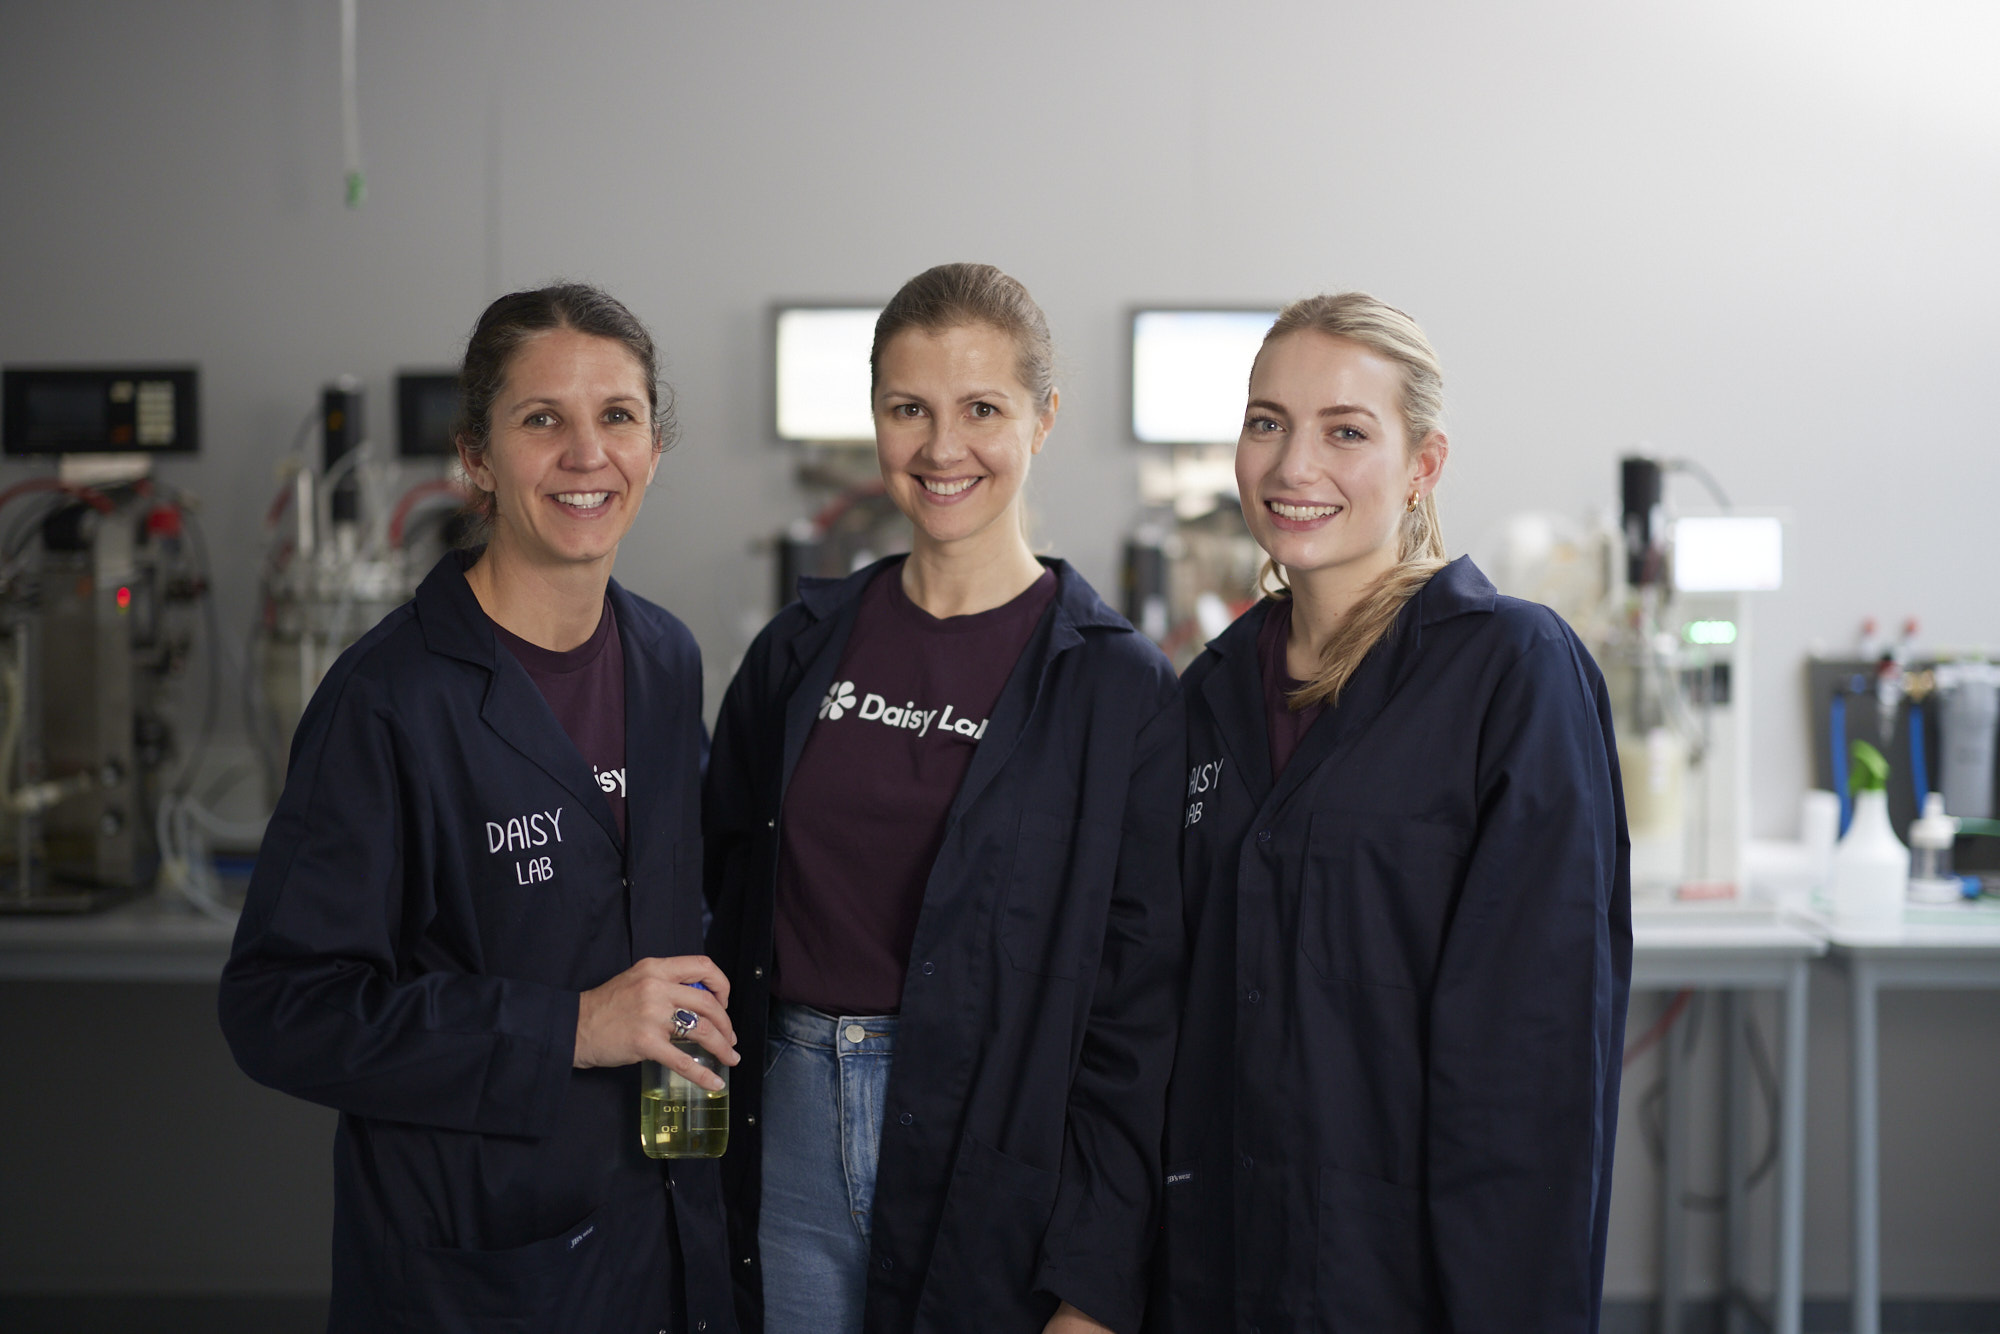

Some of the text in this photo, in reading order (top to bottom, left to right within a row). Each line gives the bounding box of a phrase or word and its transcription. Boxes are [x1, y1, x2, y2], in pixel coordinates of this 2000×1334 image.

[858, 693, 938, 737] Daisy
[1187, 757, 1224, 799] AISY
[485, 807, 563, 854] DAISY
[515, 856, 554, 885] LAB
